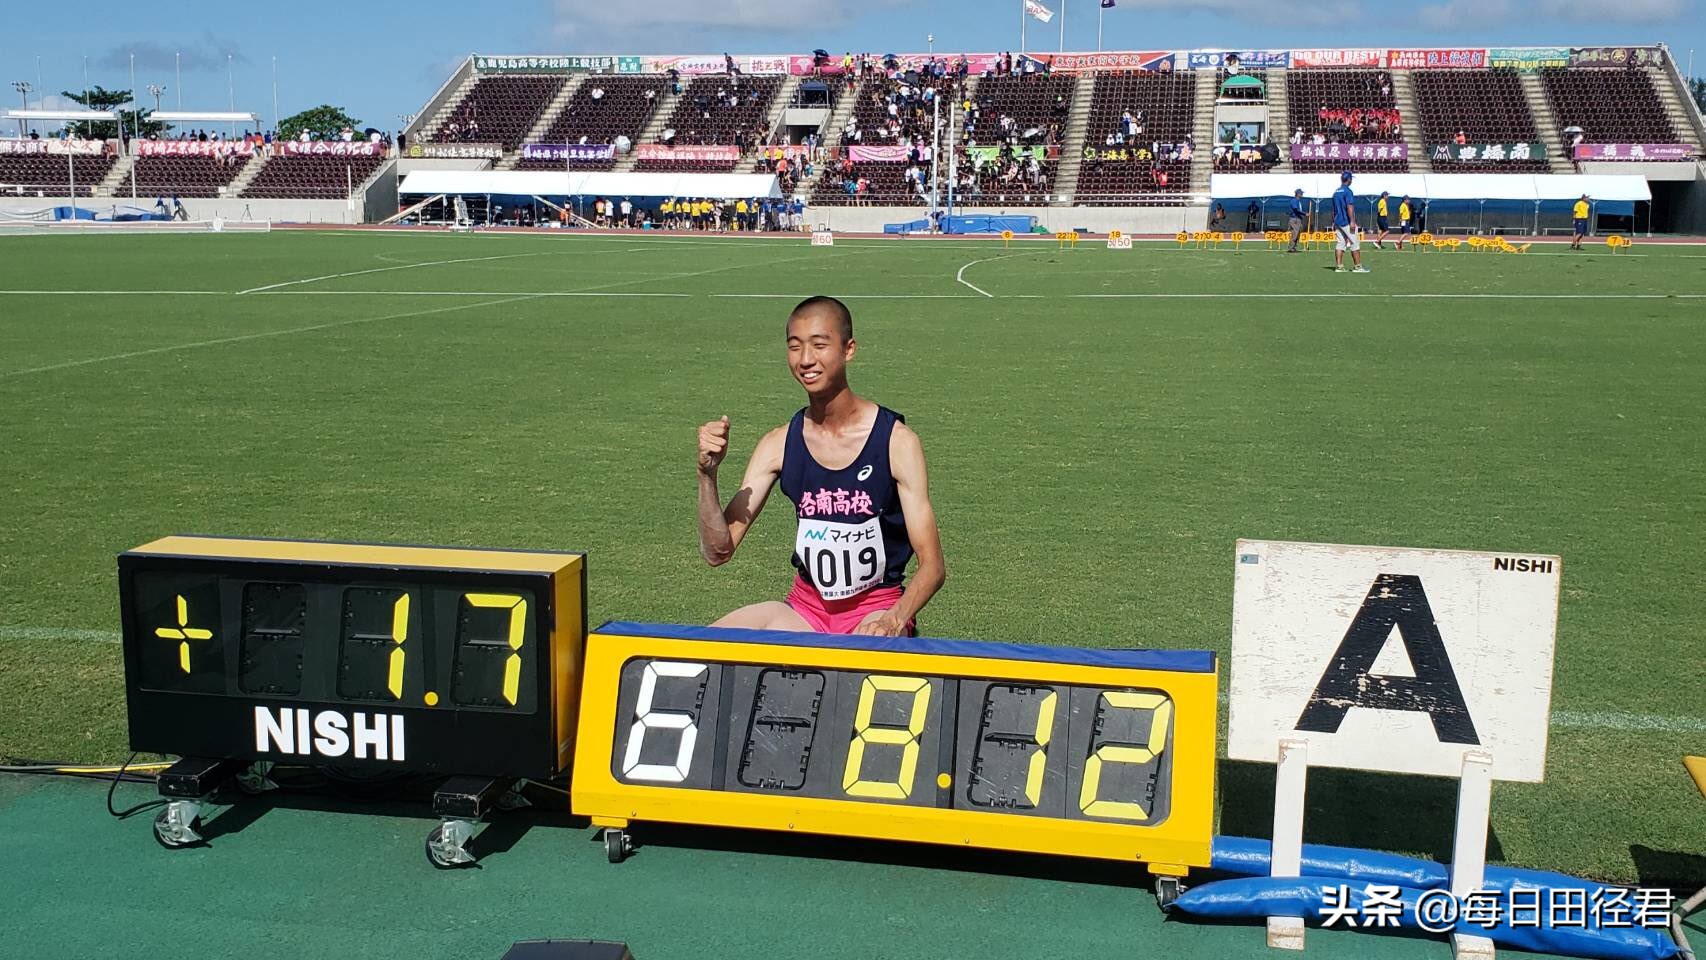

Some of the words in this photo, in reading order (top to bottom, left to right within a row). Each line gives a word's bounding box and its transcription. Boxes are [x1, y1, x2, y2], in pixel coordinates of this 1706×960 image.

[799, 487, 874, 517] 洛南高校
[830, 526, 876, 543] マイナビ
[804, 547, 878, 587] 1019
[1493, 557, 1552, 574] NISHI
[1294, 573, 1480, 745] A
[254, 706, 405, 761] NISHI
[622, 661, 708, 782] 6
